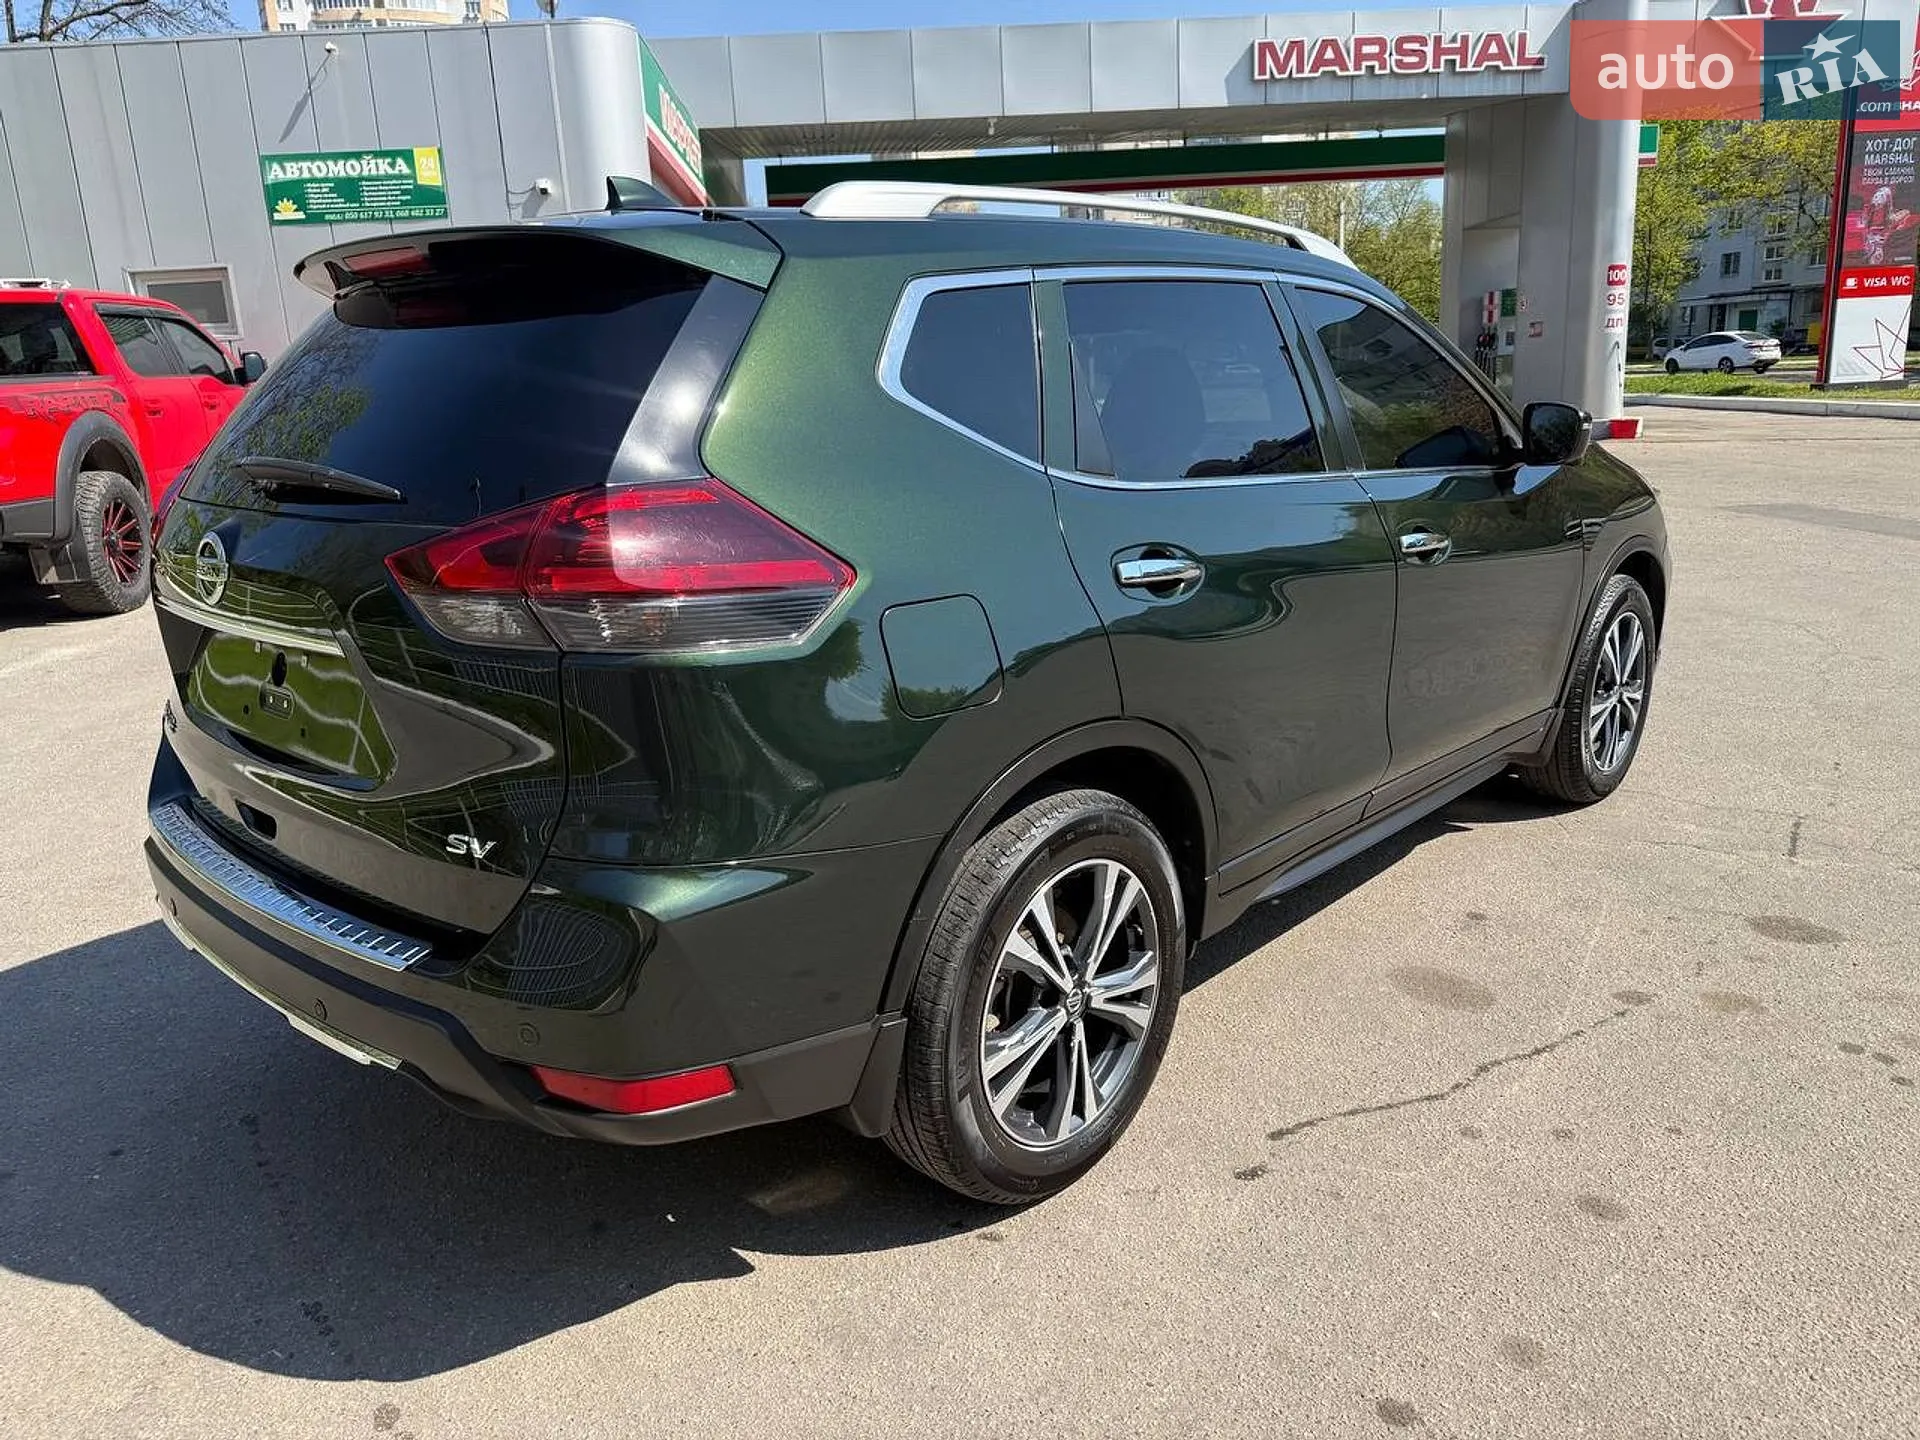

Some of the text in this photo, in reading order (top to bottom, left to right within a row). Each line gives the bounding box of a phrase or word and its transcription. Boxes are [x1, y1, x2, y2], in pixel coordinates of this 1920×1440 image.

[1253, 30, 1547, 80] MARSHAL
[1865, 137, 1917, 152] ХОТ-ДОГ
[1864, 152, 1915, 166] MARSHAL
[269, 155, 411, 180] АВТОМОЙКА
[1608, 269, 1627, 282] 100
[1863, 275, 1911, 288] VISA WC
[1607, 292, 1625, 306] 95
[445, 833, 496, 858] SV
